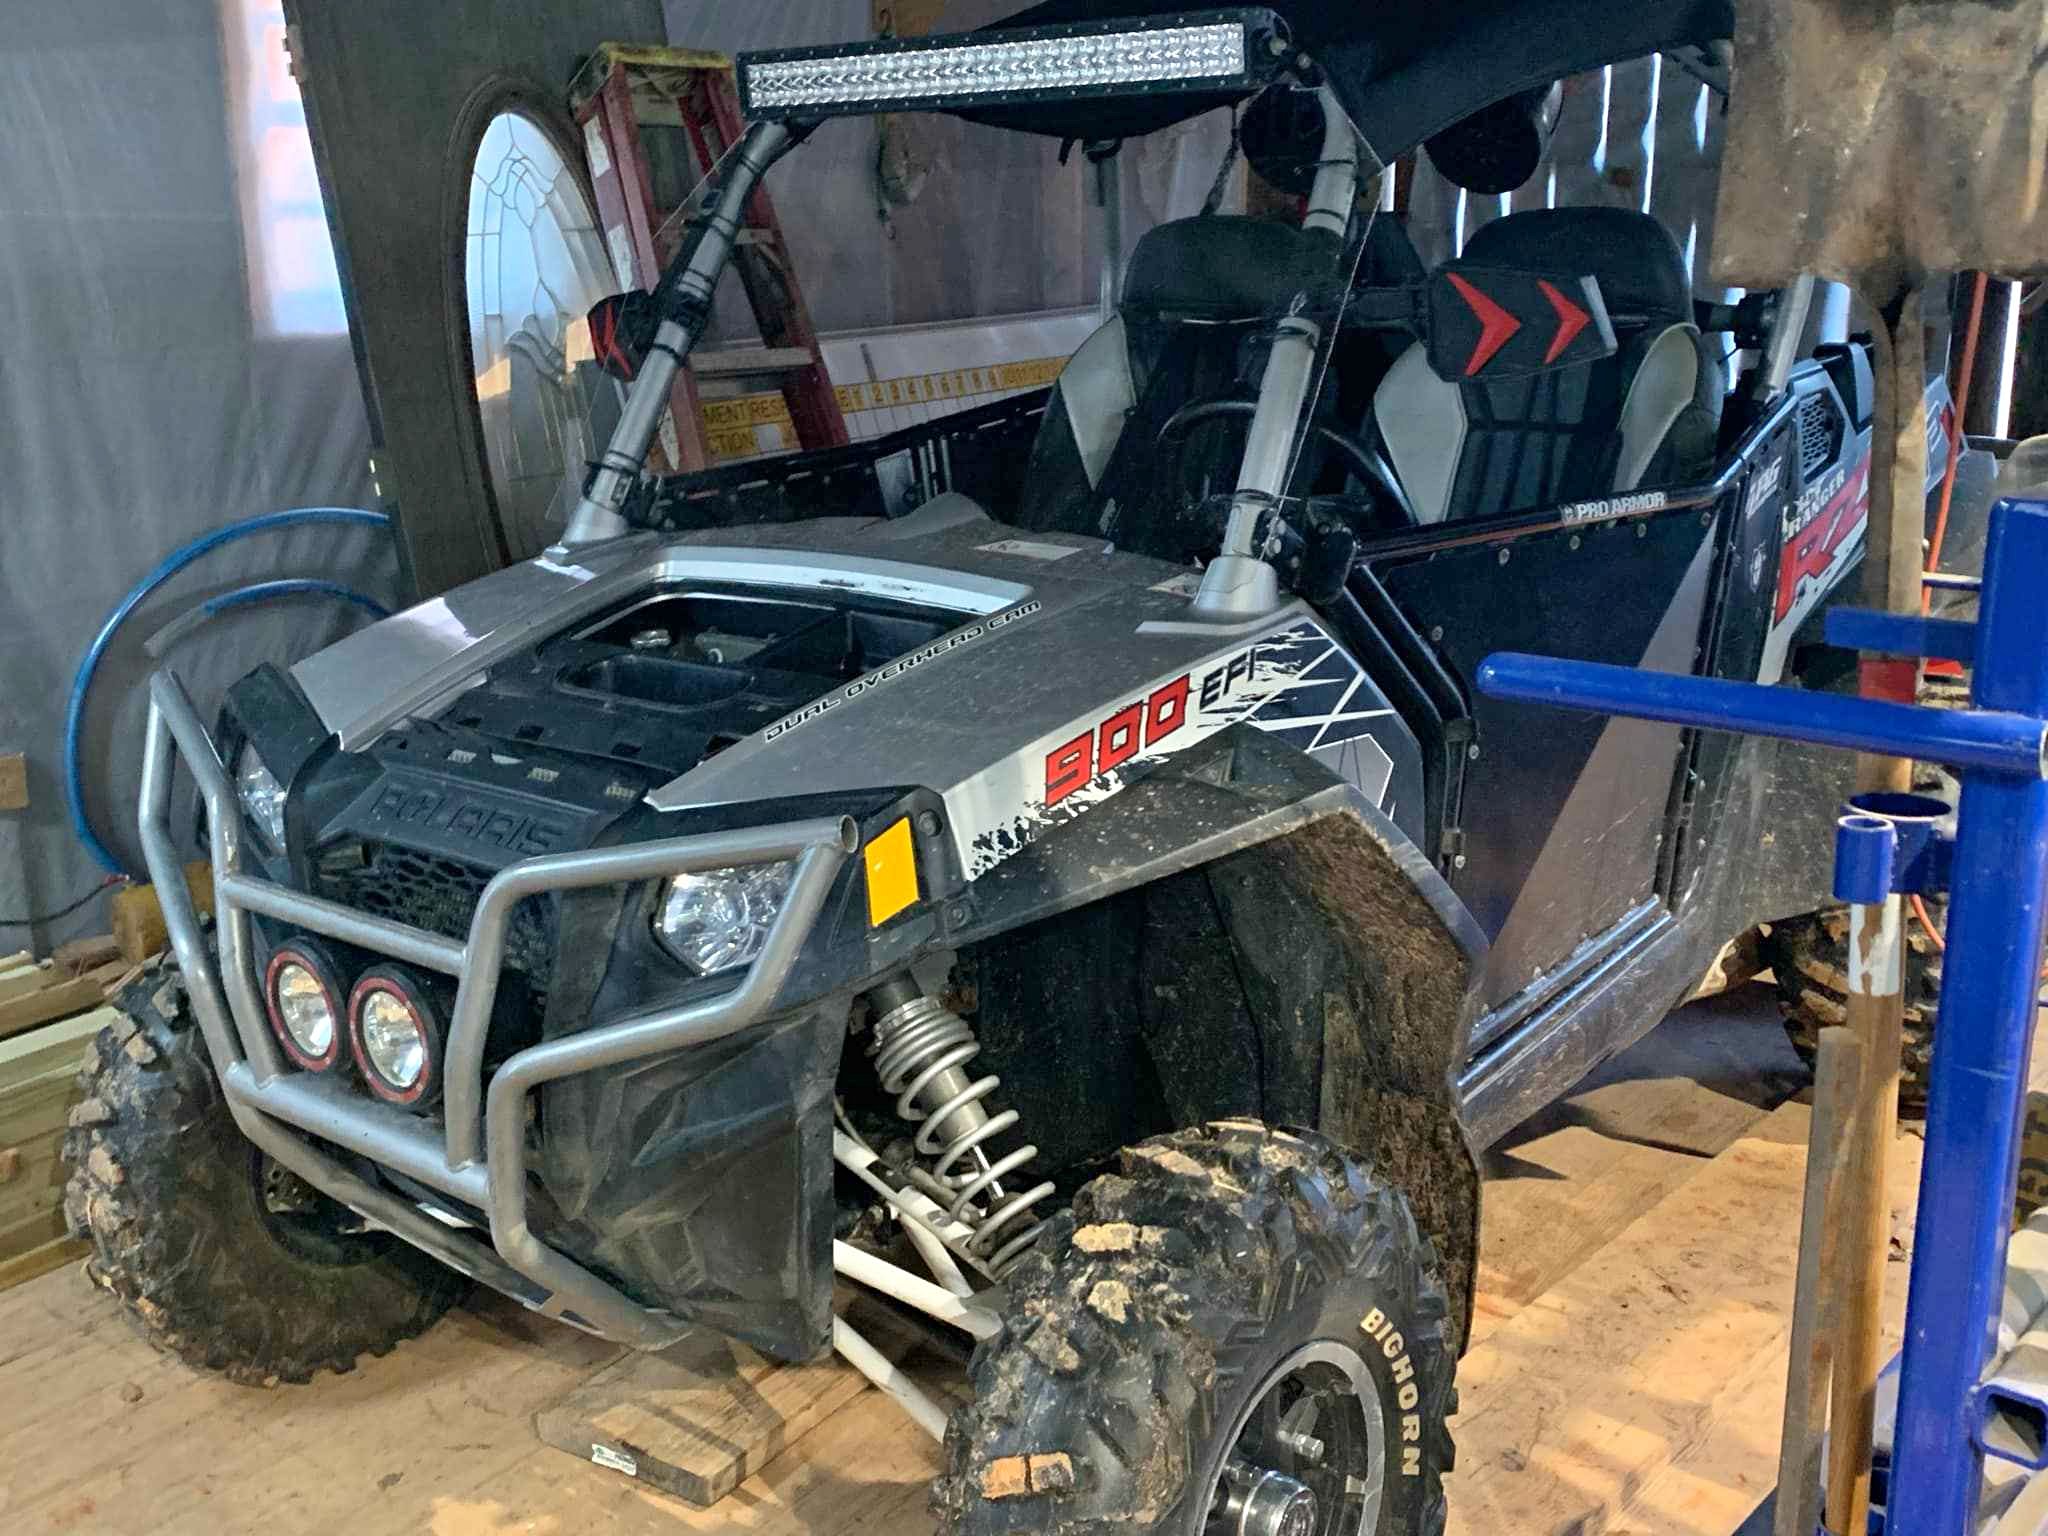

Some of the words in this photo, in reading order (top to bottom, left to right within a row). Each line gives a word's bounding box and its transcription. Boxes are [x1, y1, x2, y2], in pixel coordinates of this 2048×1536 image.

[1575, 501, 1609, 521] PRO
[1611, 491, 1668, 515] ARMOR
[765, 698, 841, 743] DUAL
[845, 626, 985, 698] OVERHEAD
[988, 600, 1041, 631] CAM
[1045, 672, 1191, 808] 900
[1199, 648, 1257, 711] EFI
[1360, 1306, 1422, 1477] BIGHORN
